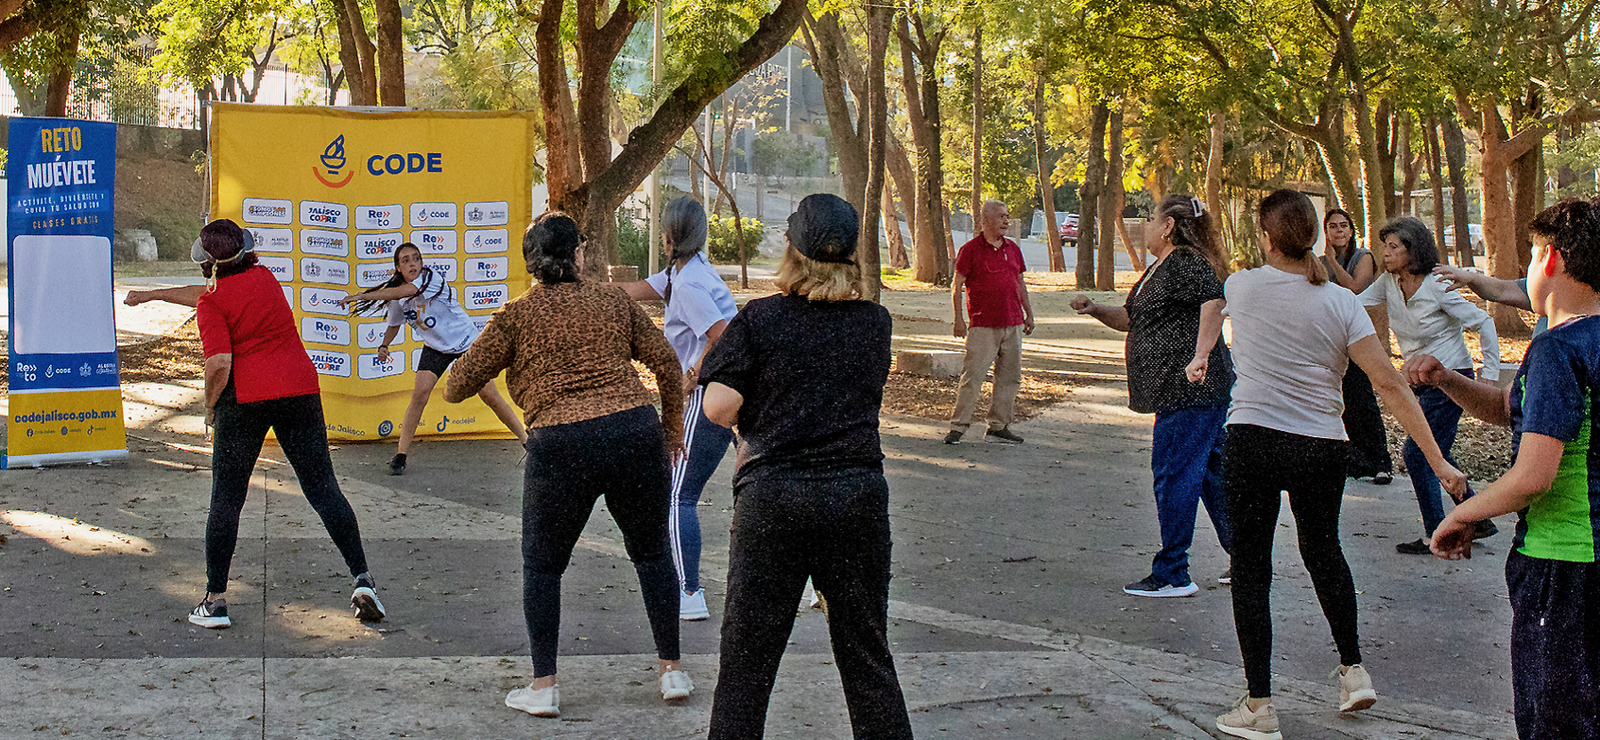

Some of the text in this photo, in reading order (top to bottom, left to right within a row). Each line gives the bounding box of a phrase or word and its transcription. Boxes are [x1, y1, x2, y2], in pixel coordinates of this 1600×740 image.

[41, 127, 82, 153] RETO
[367, 152, 443, 176] CODE
[27, 155, 96, 189] MUÉVETE
[51, 204, 60, 212] TU
[64, 202, 87, 210] SALUD
[33, 218, 64, 229] CLASES
[24, 371, 37, 382] to
[15, 409, 117, 424] codejalisco.gob.mx
[337, 424, 366, 437] Jalisco
